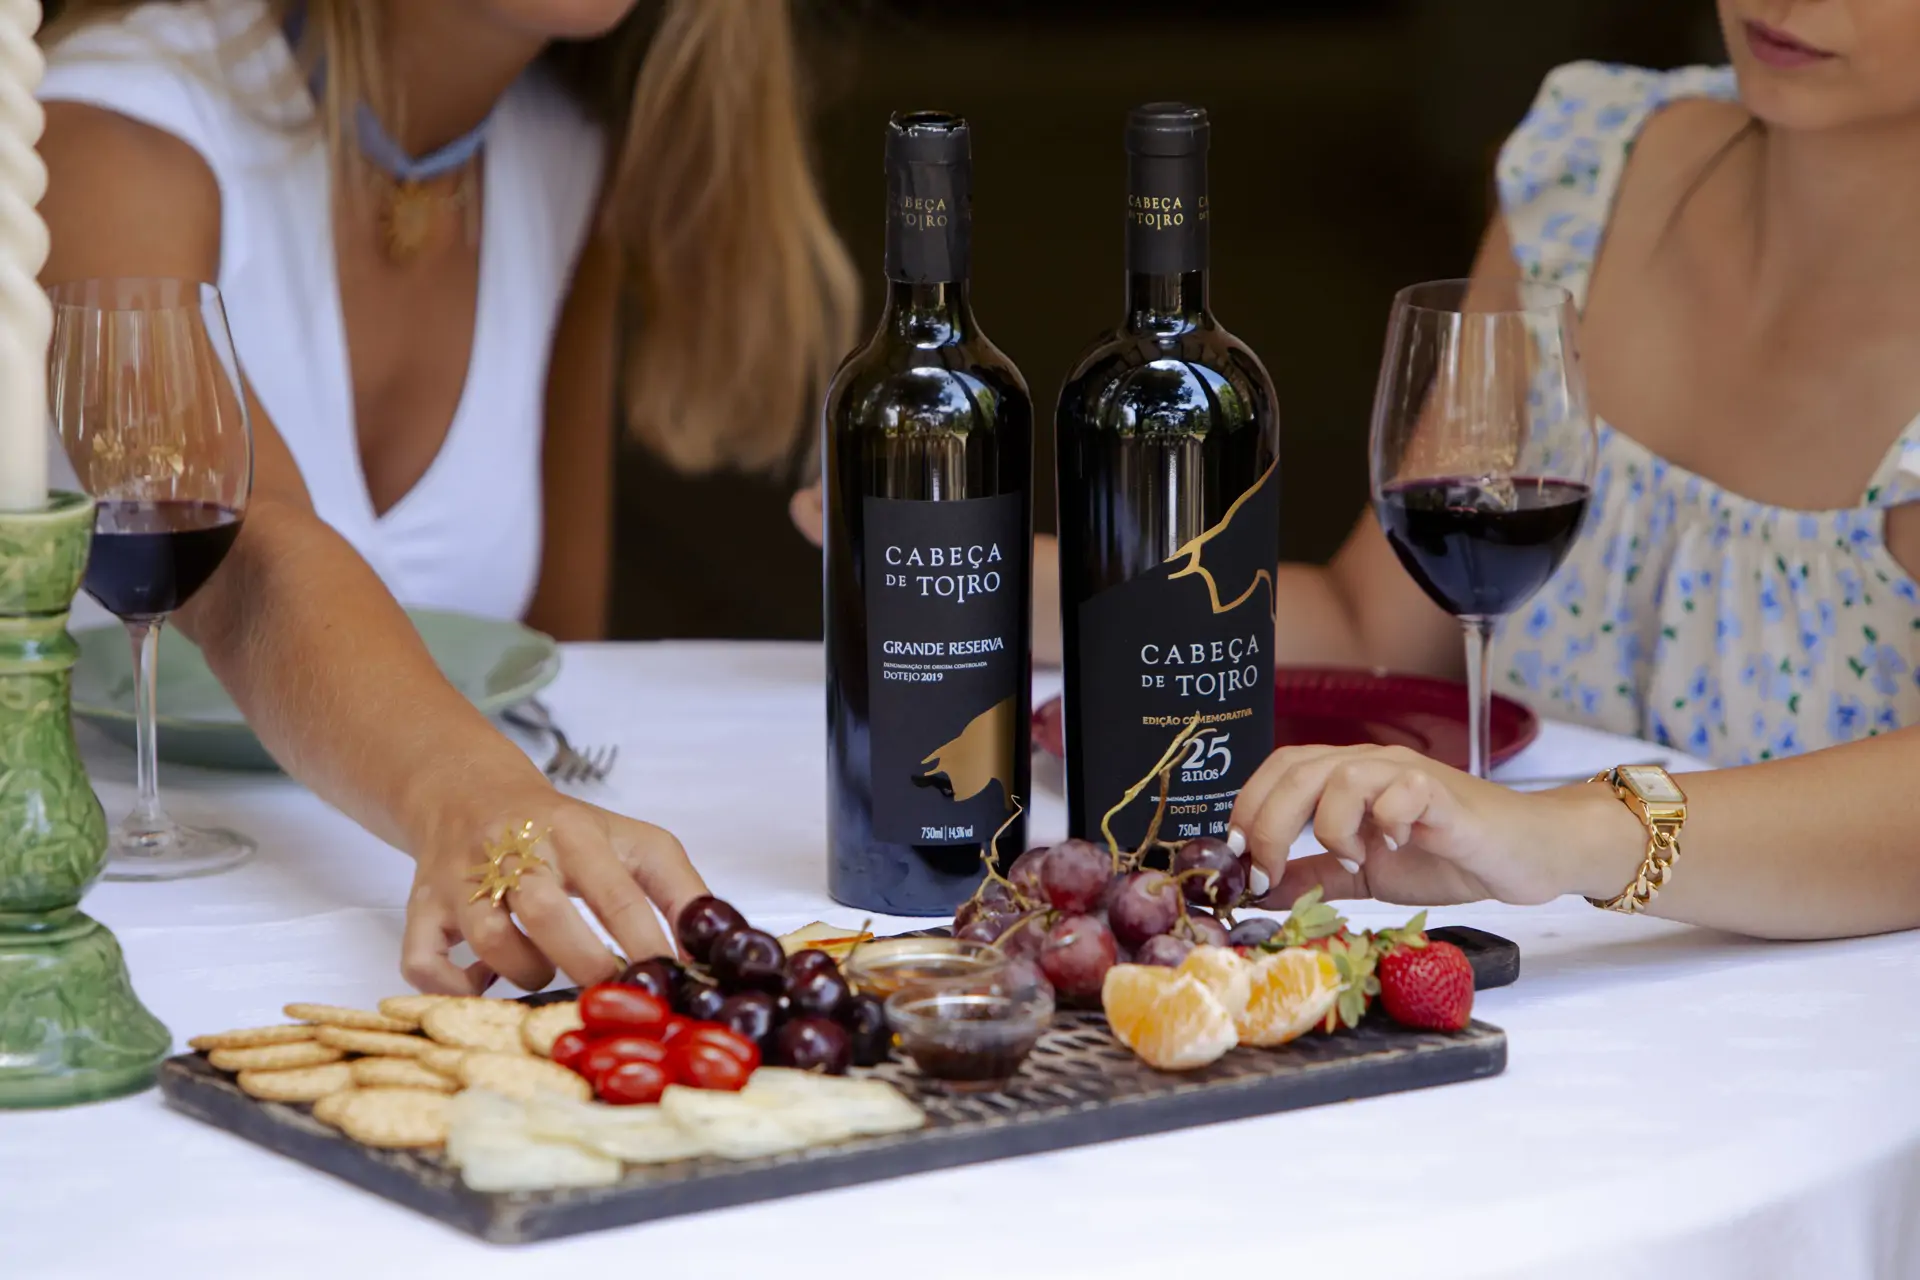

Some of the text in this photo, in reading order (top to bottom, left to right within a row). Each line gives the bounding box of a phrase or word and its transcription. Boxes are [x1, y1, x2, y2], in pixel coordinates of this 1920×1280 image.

[1128, 194, 1182, 212] CABEÇA
[1137, 212, 1184, 230] TOIRO
[885, 543, 1002, 569] CABEÇA
[886, 571, 1001, 603] DE TOIRO
[883, 637, 1004, 656] GRANDE RESERVA
[1141, 634, 1260, 664] CABEÇA
[920, 672, 943, 681] 2019
[1141, 665, 1258, 701] DE TOIRO
[1142, 715, 1181, 728] EDIÇÃO
[1181, 732, 1232, 776] 25
[1181, 768, 1219, 782] anos
[1213, 800, 1234, 812] 2016
[921, 826, 944, 839] 750ml
[1178, 823, 1202, 837] 750ml
